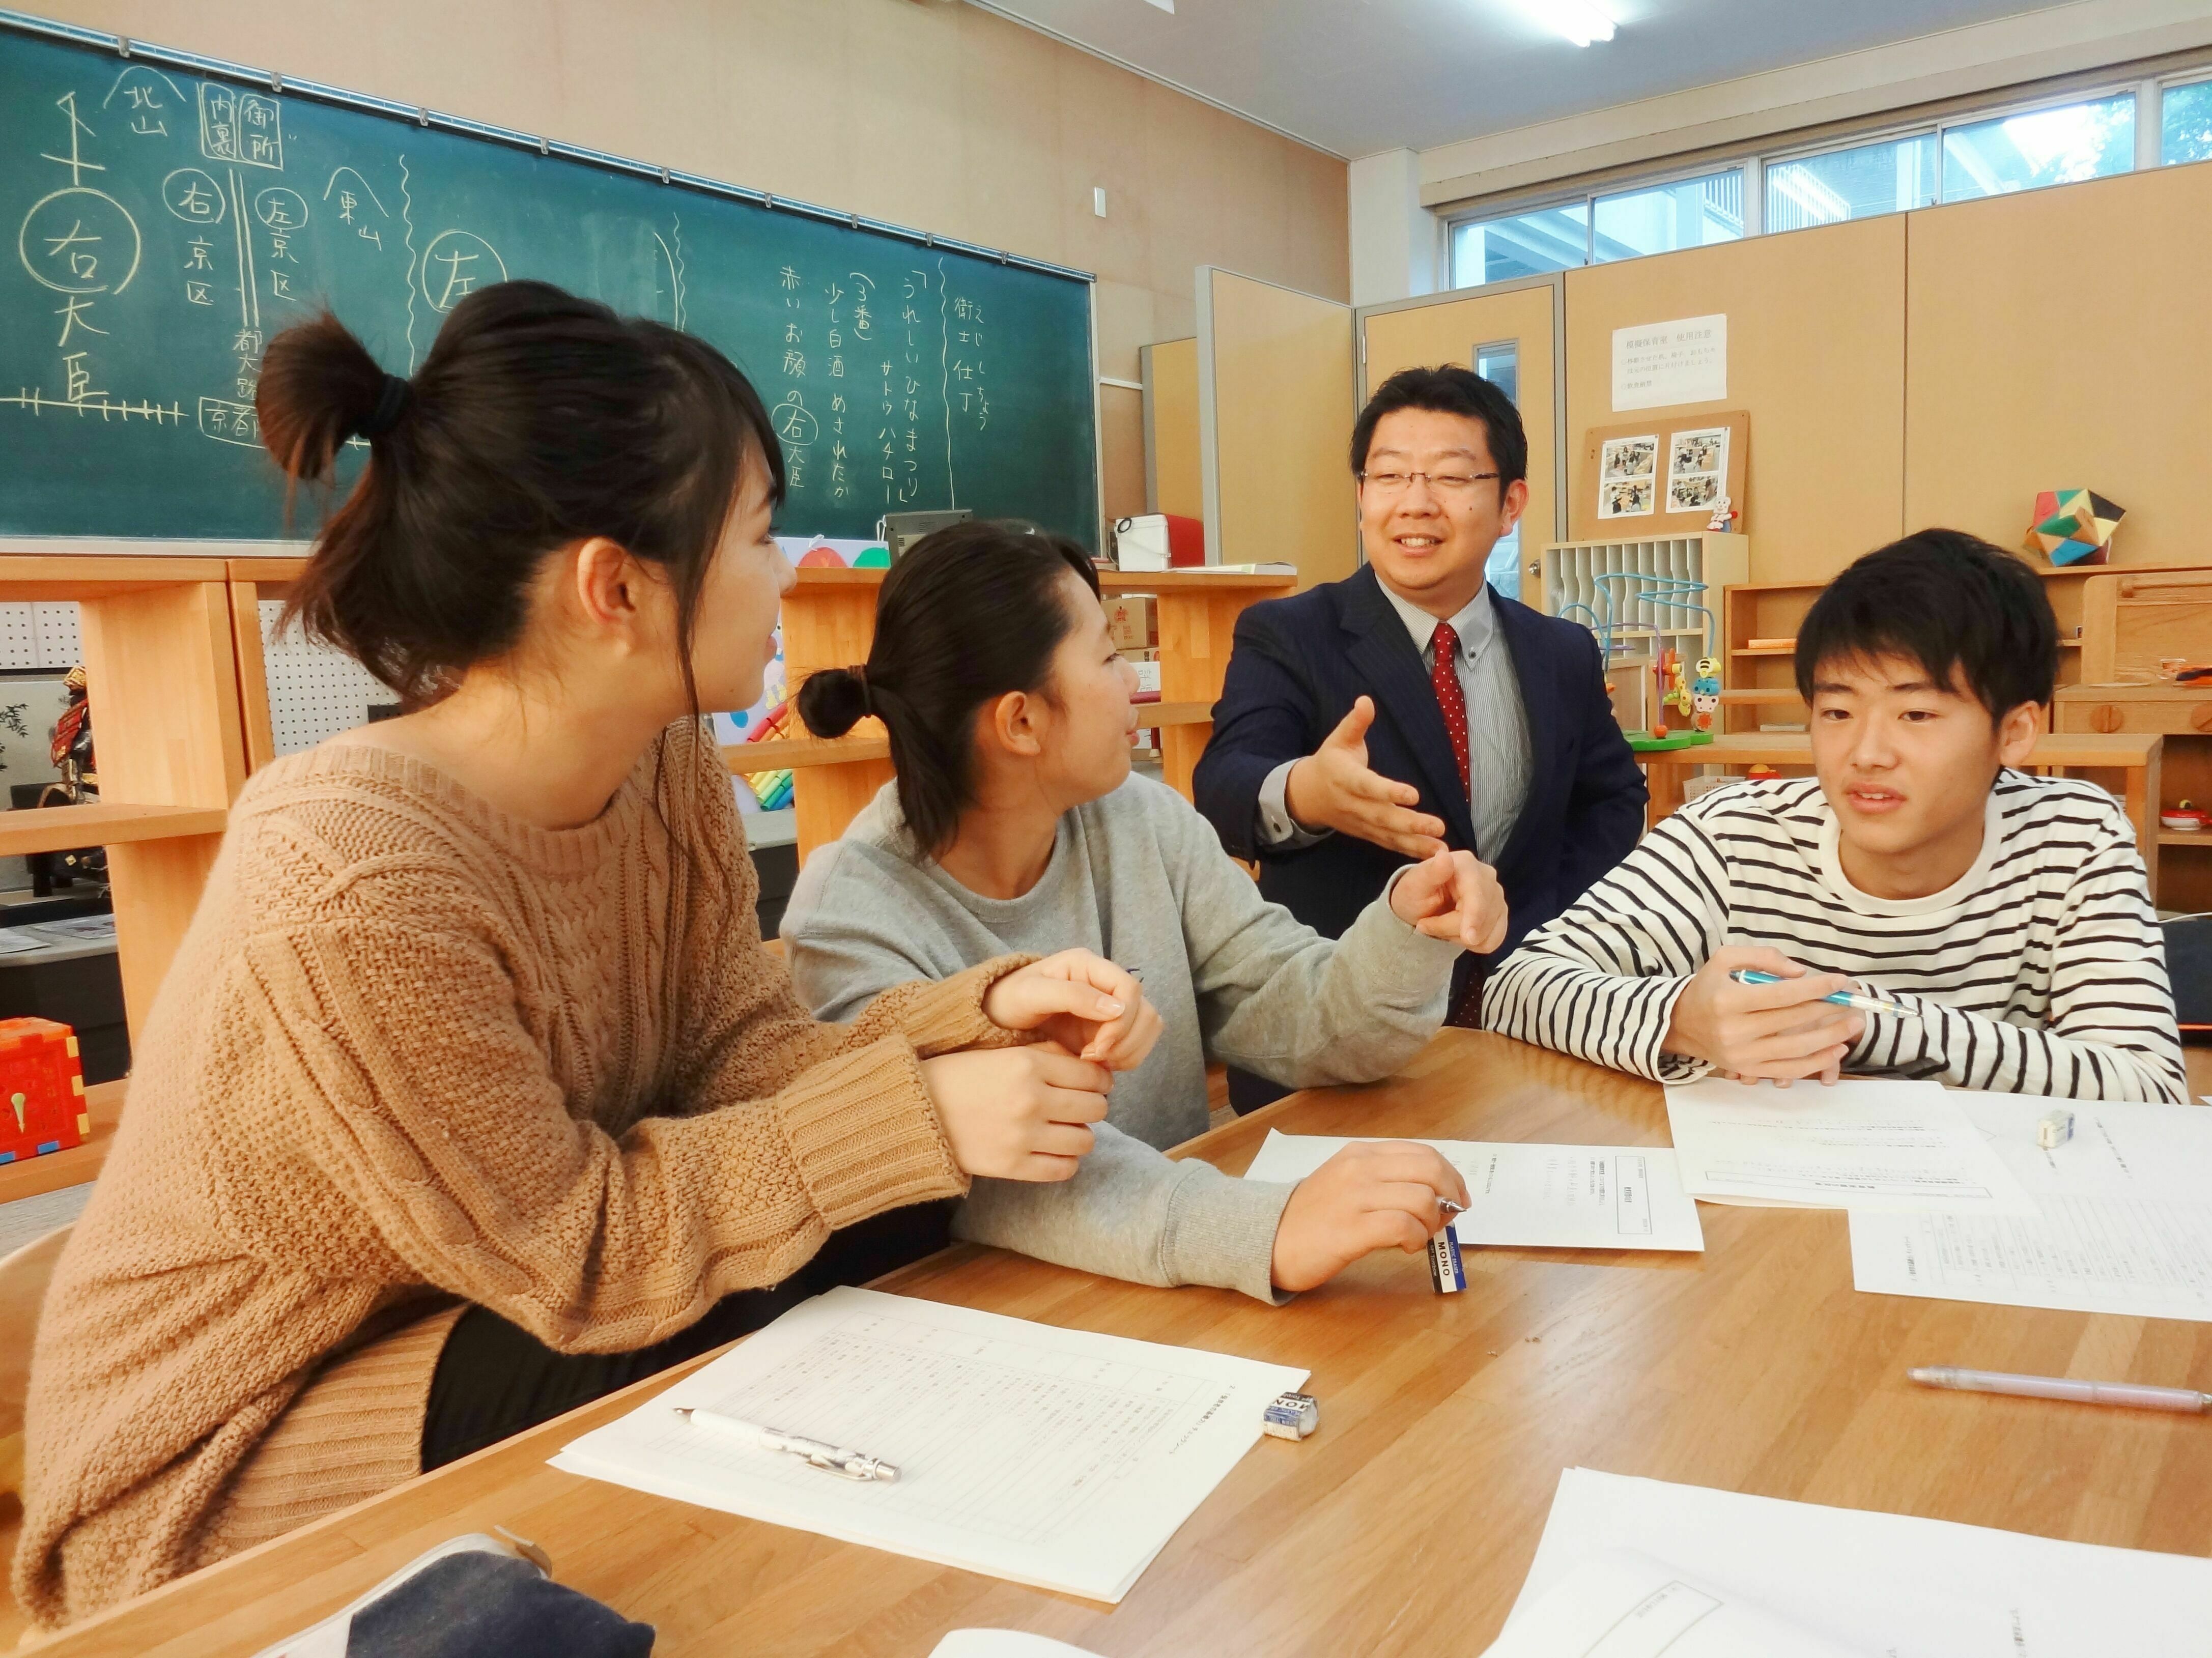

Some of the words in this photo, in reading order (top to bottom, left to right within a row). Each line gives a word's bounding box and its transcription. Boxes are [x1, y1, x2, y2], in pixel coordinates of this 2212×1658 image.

[124, 86, 167, 136] 北山
[211, 94, 233, 155] 内裏
[244, 100, 279, 161] 御所
[179, 182, 213, 305] 右京区
[266, 197, 299, 301] 左京区
[339, 191, 382, 251] 東山
[44, 220, 109, 402] 右大臣
[1438, 1242, 1450, 1276] MONO
